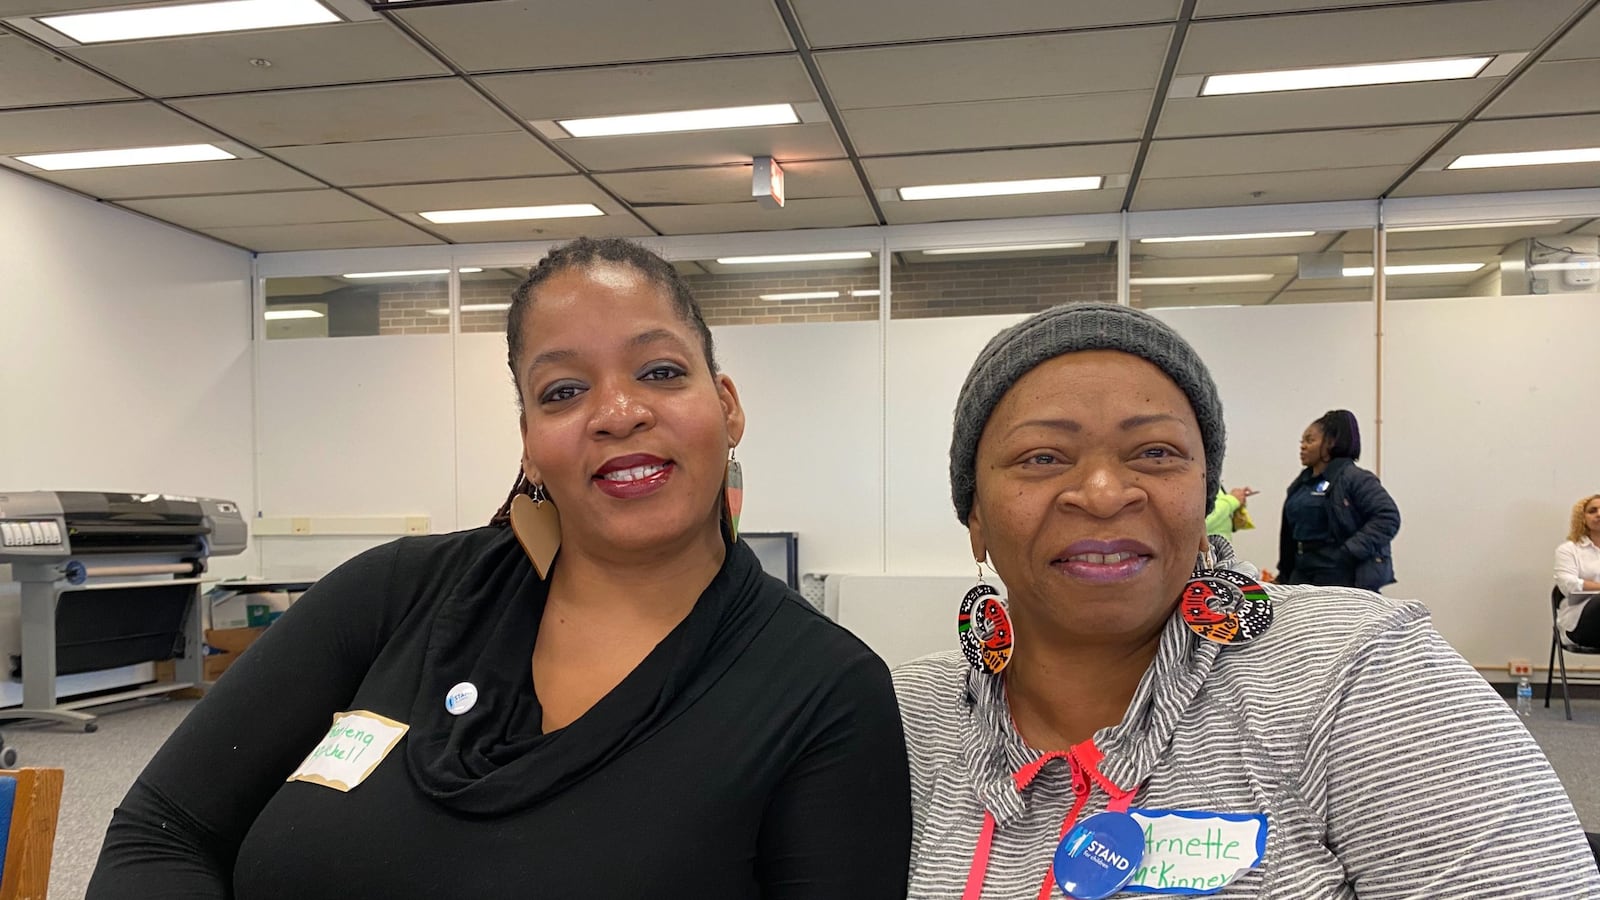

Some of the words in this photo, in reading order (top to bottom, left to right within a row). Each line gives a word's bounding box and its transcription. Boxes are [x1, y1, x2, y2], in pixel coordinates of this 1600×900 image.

[1083, 849, 1092, 858] for
[1087, 840, 1130, 871] STAND
[1144, 822, 1240, 860] Arnette
